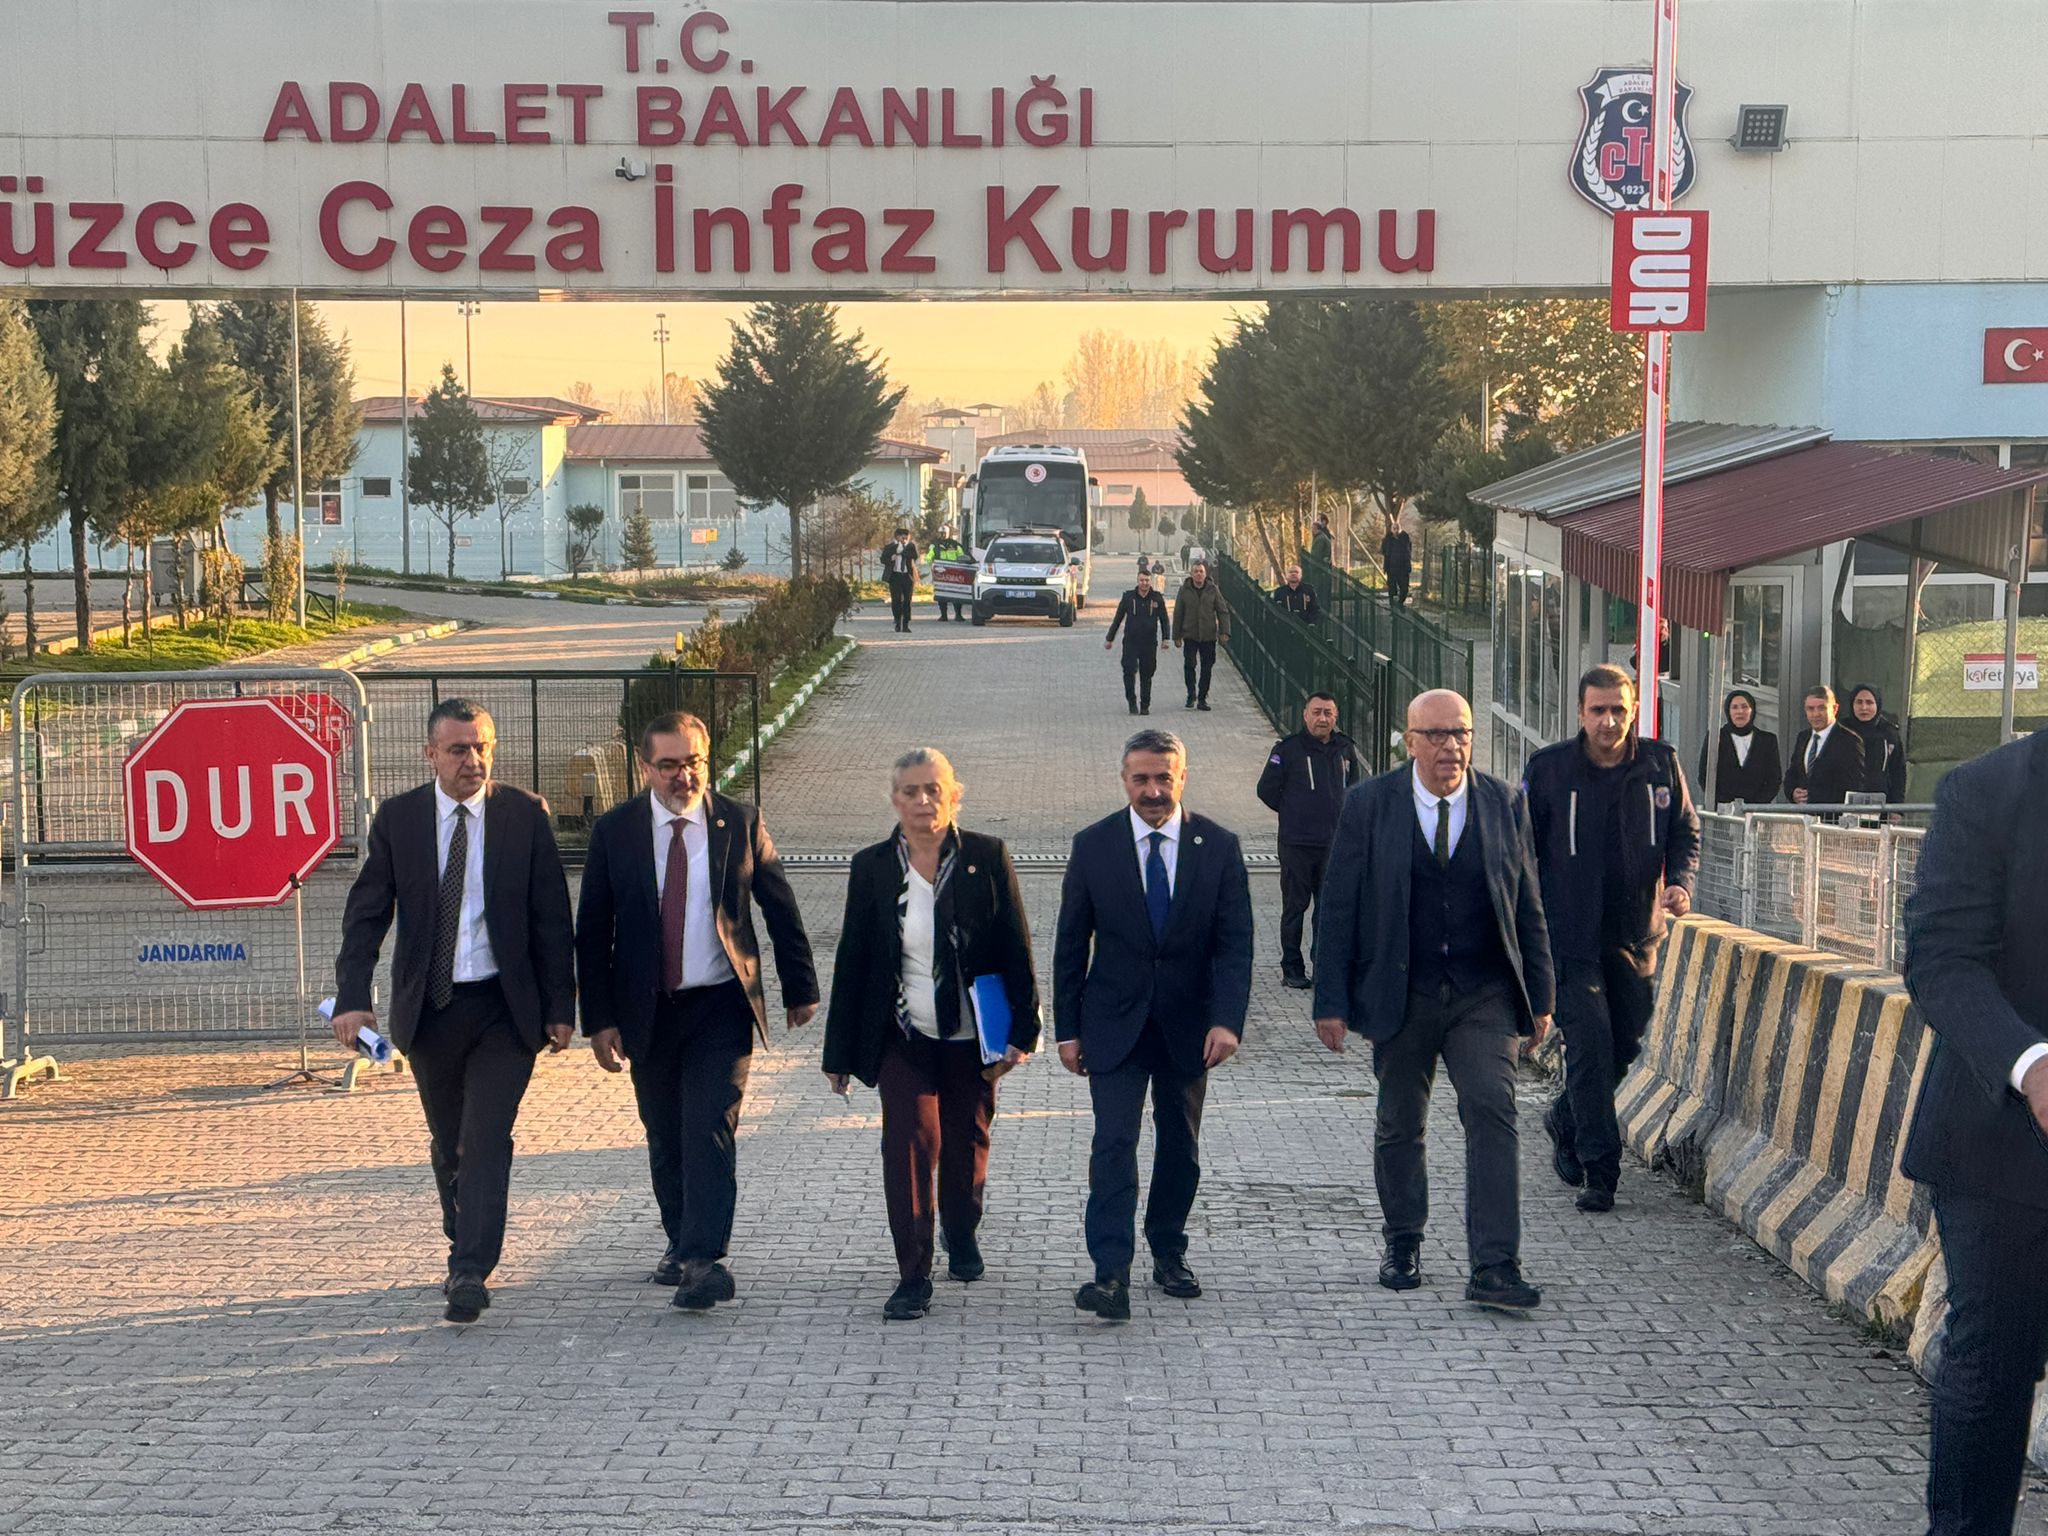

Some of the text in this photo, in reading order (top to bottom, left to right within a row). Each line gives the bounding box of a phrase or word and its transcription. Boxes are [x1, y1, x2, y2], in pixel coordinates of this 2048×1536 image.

[607, 11, 754, 74] T.C.
[262, 74, 1094, 148] ADALET BAKANLIĞI
[318, 180, 604, 273] Ceza
[654, 163, 937, 273] İnfaz
[986, 184, 1435, 274] Kurumu
[1620, 185, 1645, 195] 1923
[1628, 216, 1693, 325] DUR
[144, 762, 316, 843] DUR
[138, 943, 247, 962] JANDARMA
